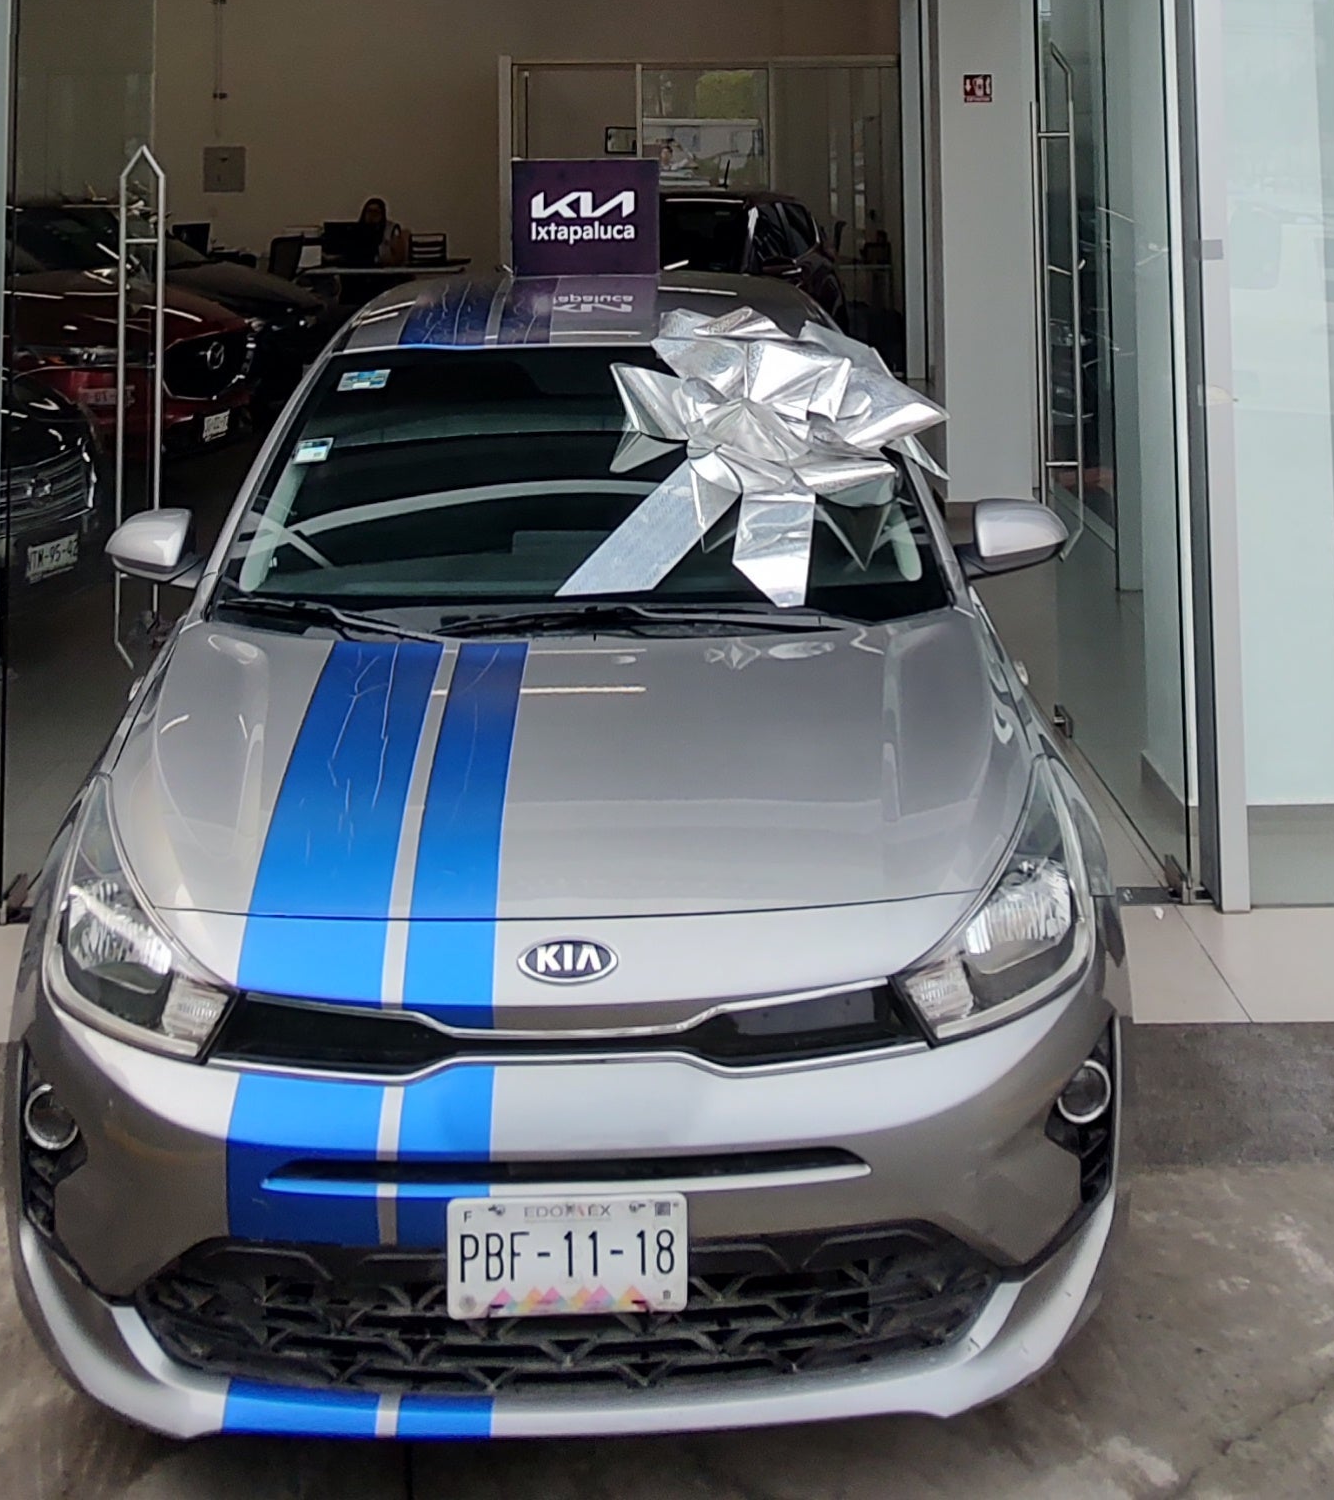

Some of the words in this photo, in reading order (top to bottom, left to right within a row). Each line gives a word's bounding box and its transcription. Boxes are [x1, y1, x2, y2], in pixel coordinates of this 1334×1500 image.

[531, 190, 635, 219] KIA
[531, 221, 635, 245] Ixtapaluca
[536, 944, 602, 973] KIA
[460, 1228, 675, 1283] PBF-11-18
